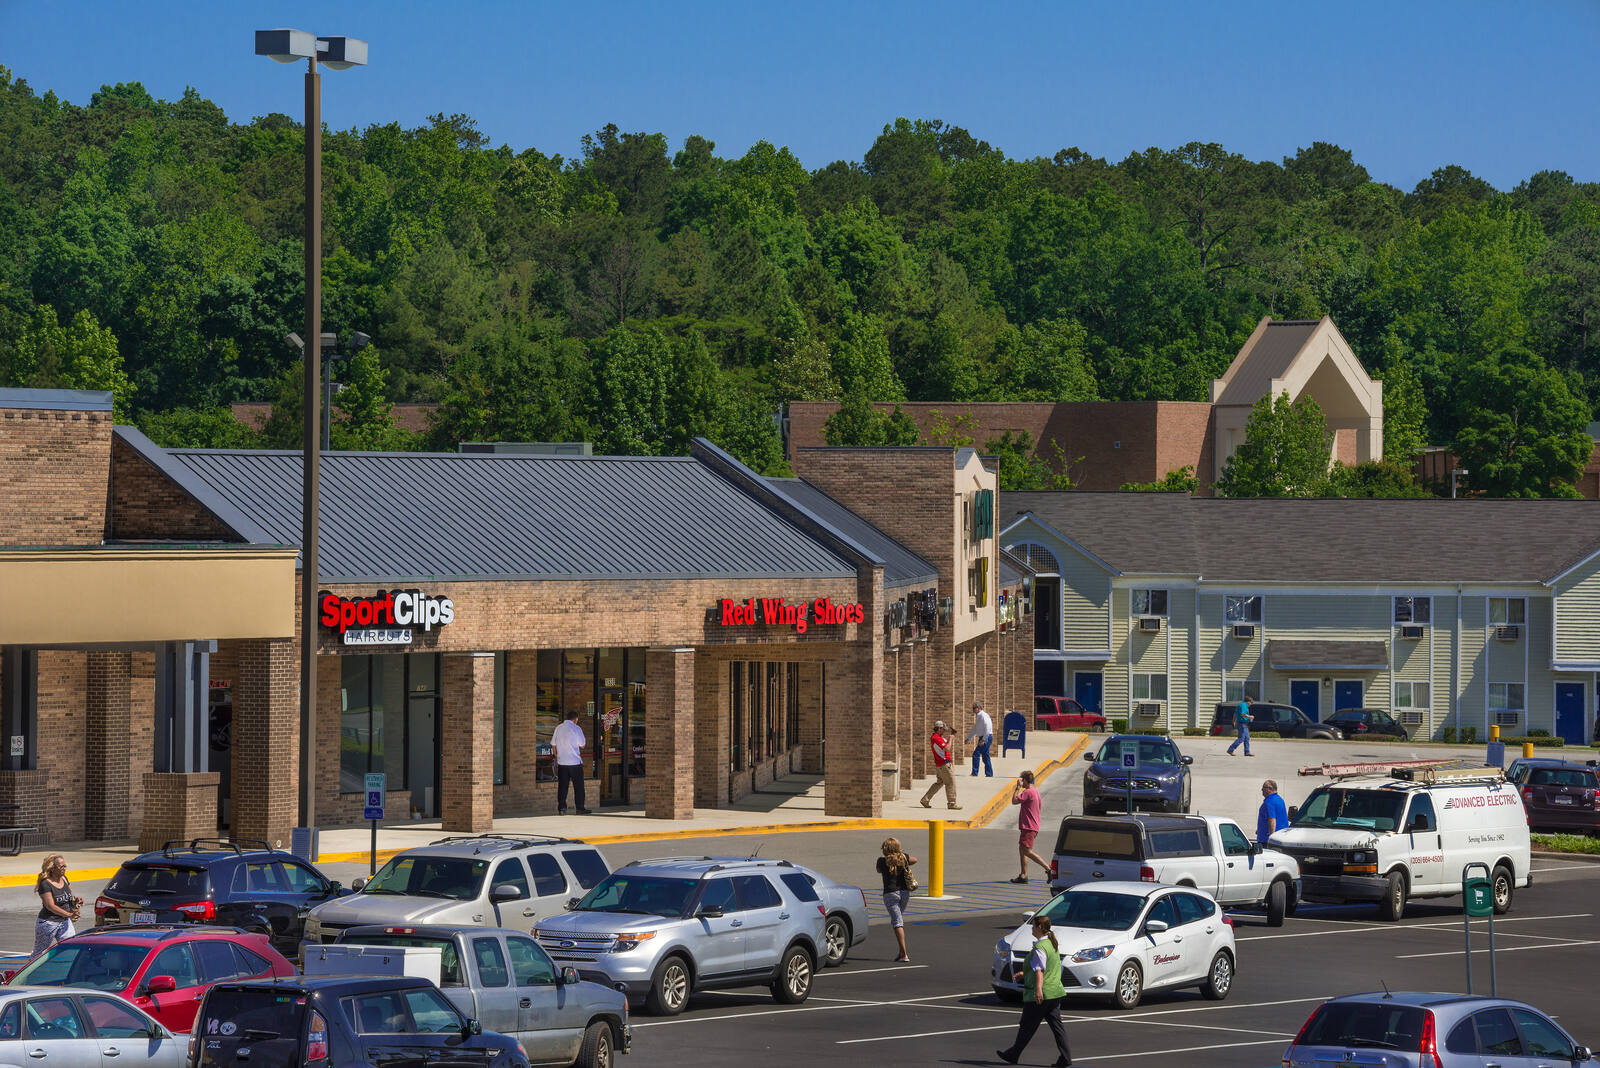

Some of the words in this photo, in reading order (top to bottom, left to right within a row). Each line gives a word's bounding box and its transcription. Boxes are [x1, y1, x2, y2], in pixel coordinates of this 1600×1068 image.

[721, 597, 755, 625] Red
[761, 596, 807, 633] Wing
[814, 596, 864, 625] Shoes
[345, 631, 411, 642] HAIRCUTS
[1450, 796, 1486, 809] ADVANCED
[1486, 793, 1518, 807] ELECTRIC
